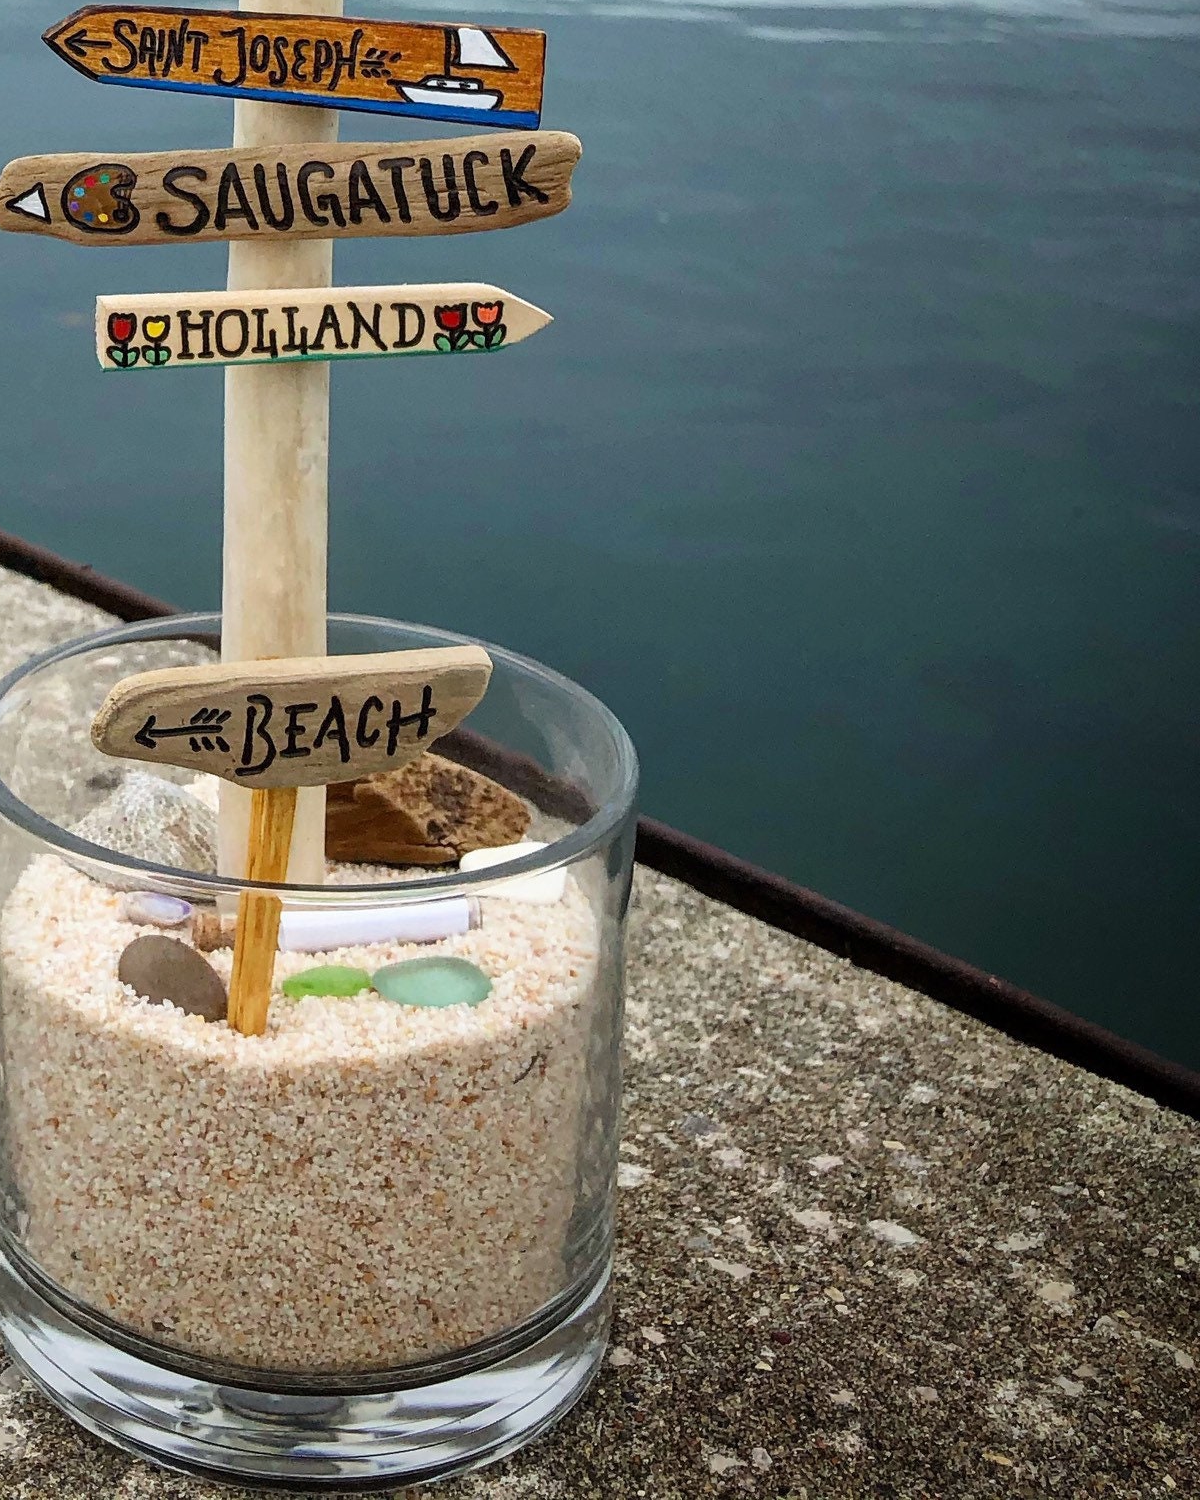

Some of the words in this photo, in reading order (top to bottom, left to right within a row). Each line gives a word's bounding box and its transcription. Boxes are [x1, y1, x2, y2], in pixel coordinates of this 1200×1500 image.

[101, 18, 209, 74] SAINT
[212, 26, 363, 88] JOSEPH
[155, 144, 550, 236] SAUGATUCK
[177, 301, 425, 360] HOLLAND
[235, 685, 437, 776] BEACH
